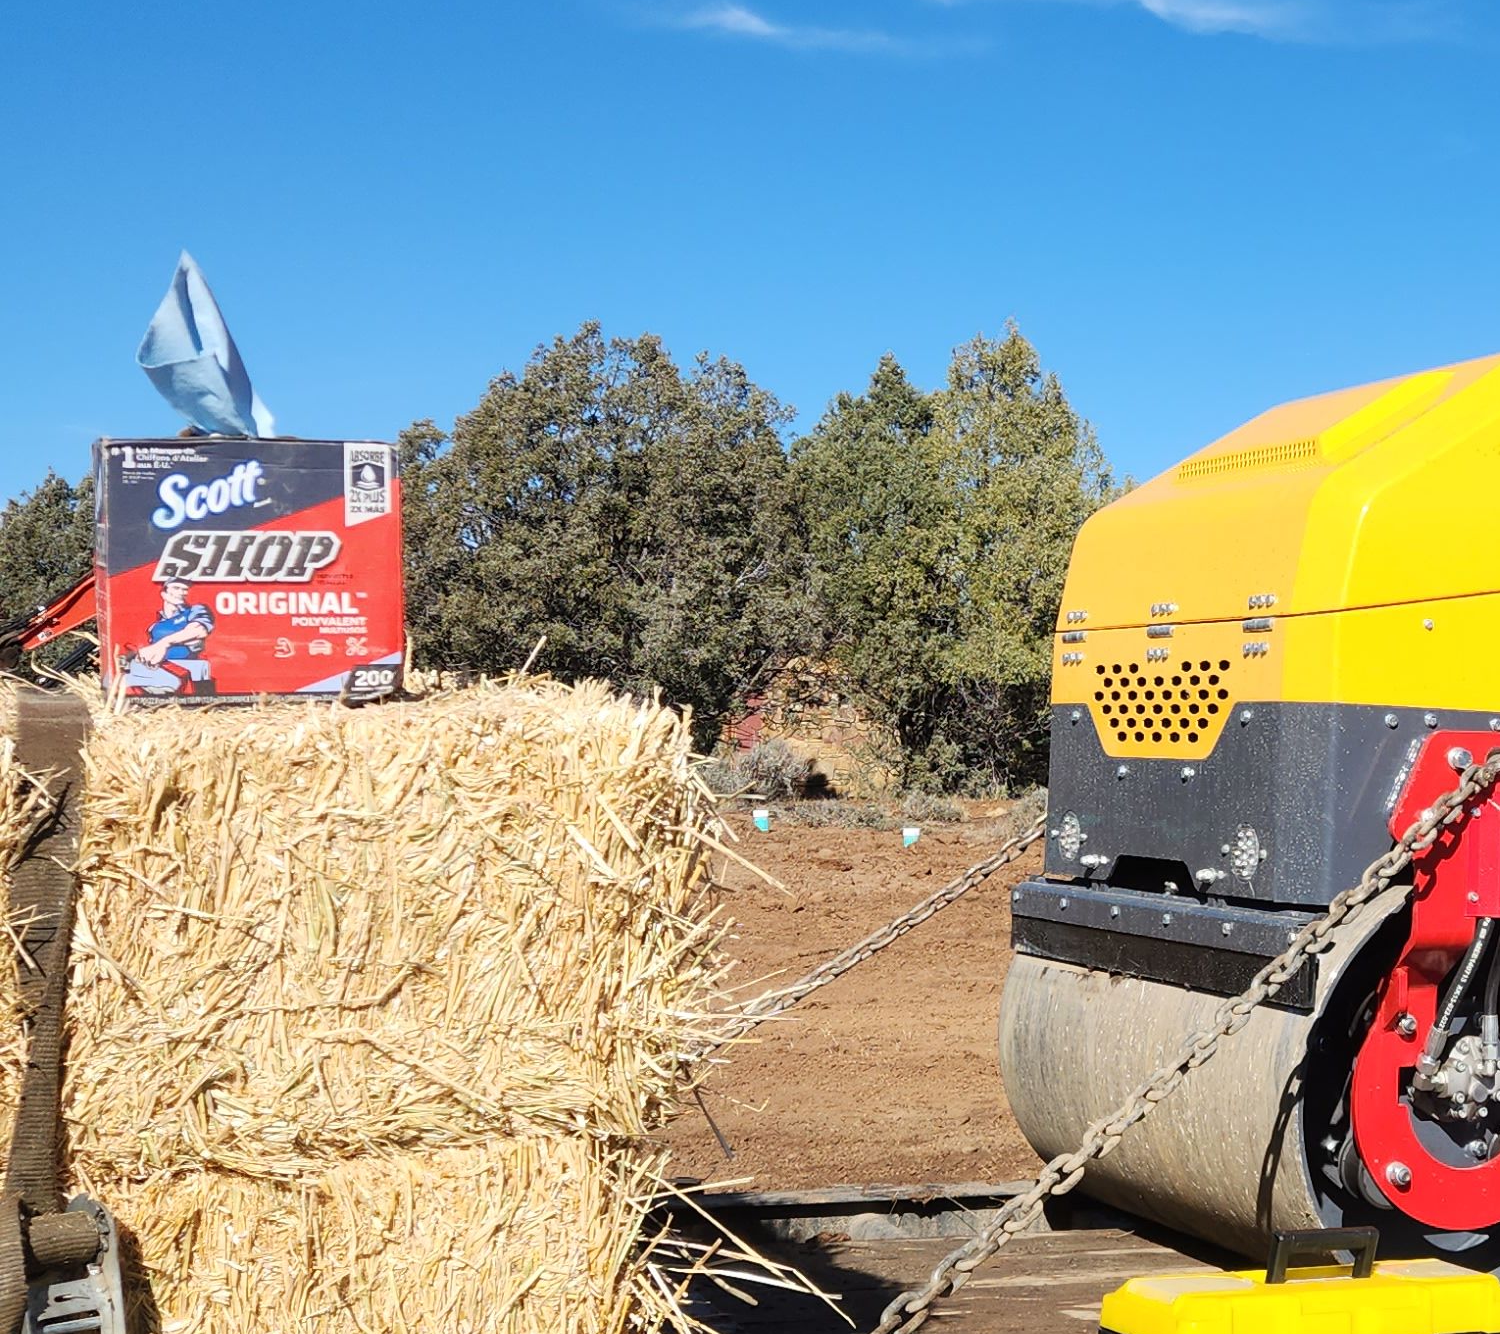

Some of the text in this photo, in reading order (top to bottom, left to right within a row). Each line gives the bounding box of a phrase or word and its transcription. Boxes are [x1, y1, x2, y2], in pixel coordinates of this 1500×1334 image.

[350, 450, 385, 464] ABSORBE
[152, 461, 263, 529] Scott
[363, 490, 385, 503] PLUS
[155, 532, 339, 579] SHOP
[291, 617, 368, 627] POLYVALENT
[354, 669, 395, 687] 200
